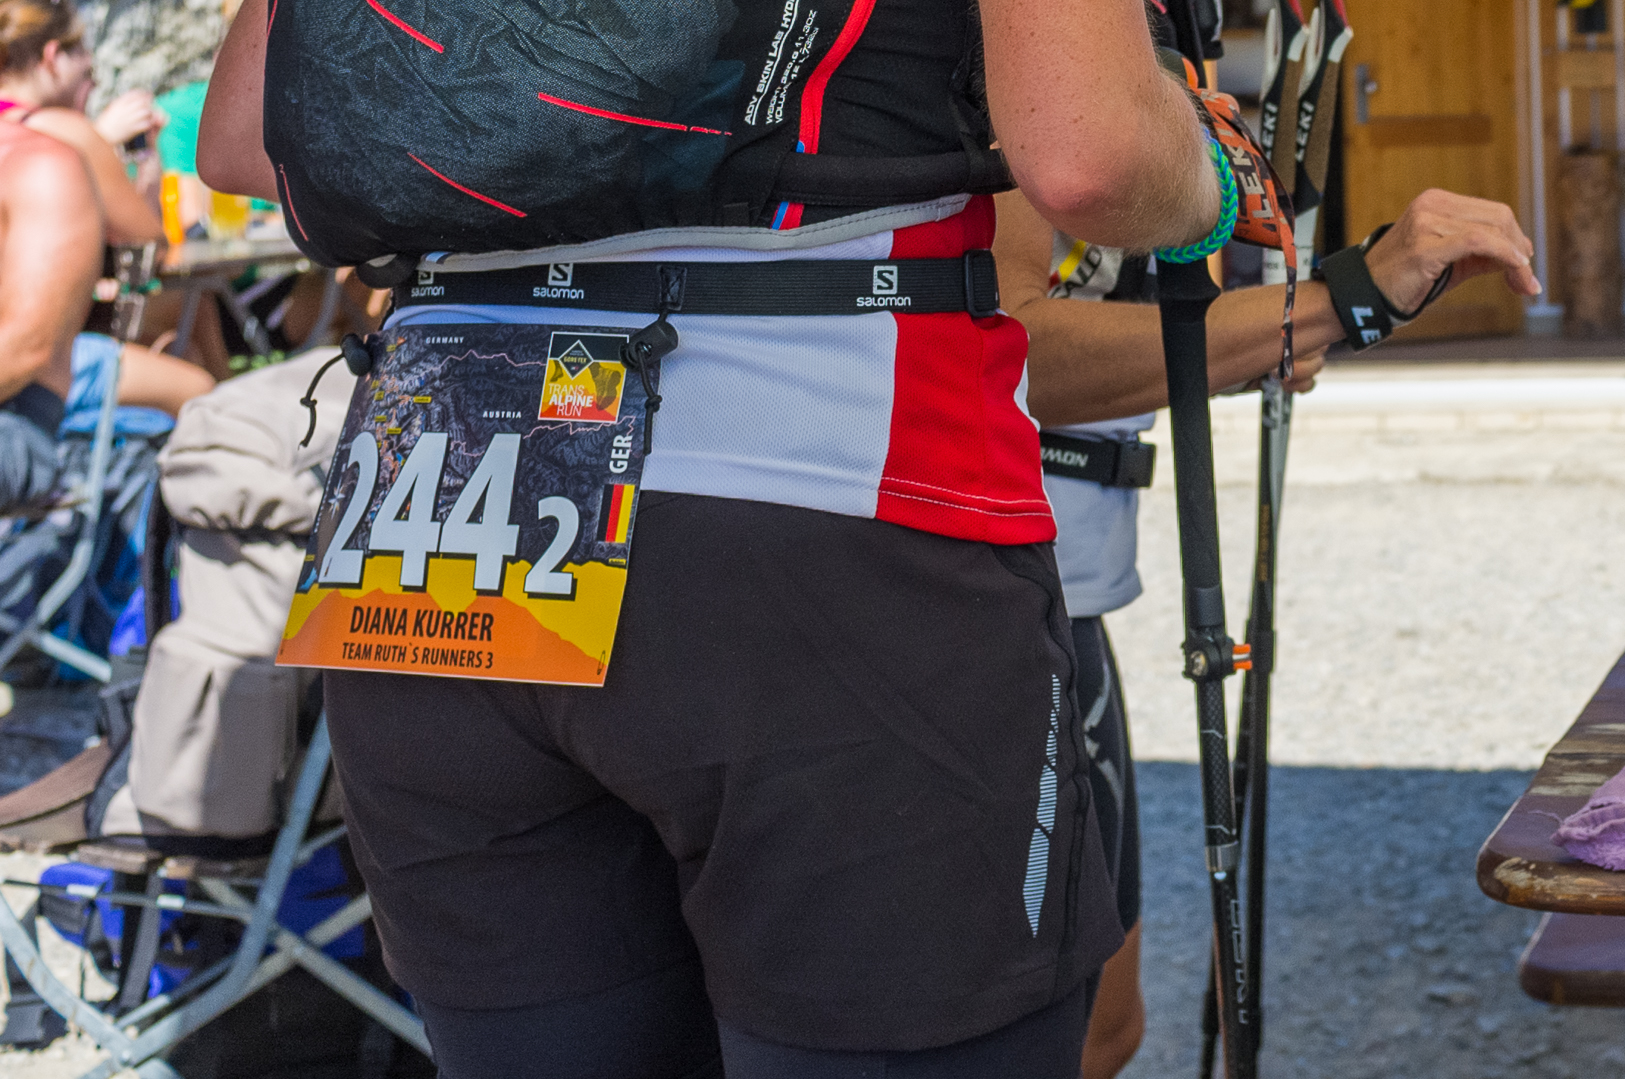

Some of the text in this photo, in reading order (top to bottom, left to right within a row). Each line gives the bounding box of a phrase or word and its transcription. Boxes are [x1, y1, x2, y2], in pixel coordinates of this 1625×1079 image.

[744, 95, 758, 125] ADV
[756, 60, 774, 94] SKIN
[768, 30, 784, 57] LAB
[1296, 101, 1315, 162] LEKI
[425, 336, 465, 345] GERMANY
[548, 383, 585, 395] TRANS
[549, 394, 593, 408] ALPINE
[483, 410, 522, 419] AUSTRIA
[556, 405, 582, 417] RUN
[609, 434, 633, 474] GER
[318, 431, 522, 591] 244
[523, 495, 580, 596] 2
[350, 605, 494, 642] DIANA KURRER
[342, 642, 372, 661] TEAM
[421, 648, 483, 668] RUNNERS
[485, 651, 494, 669] 3
